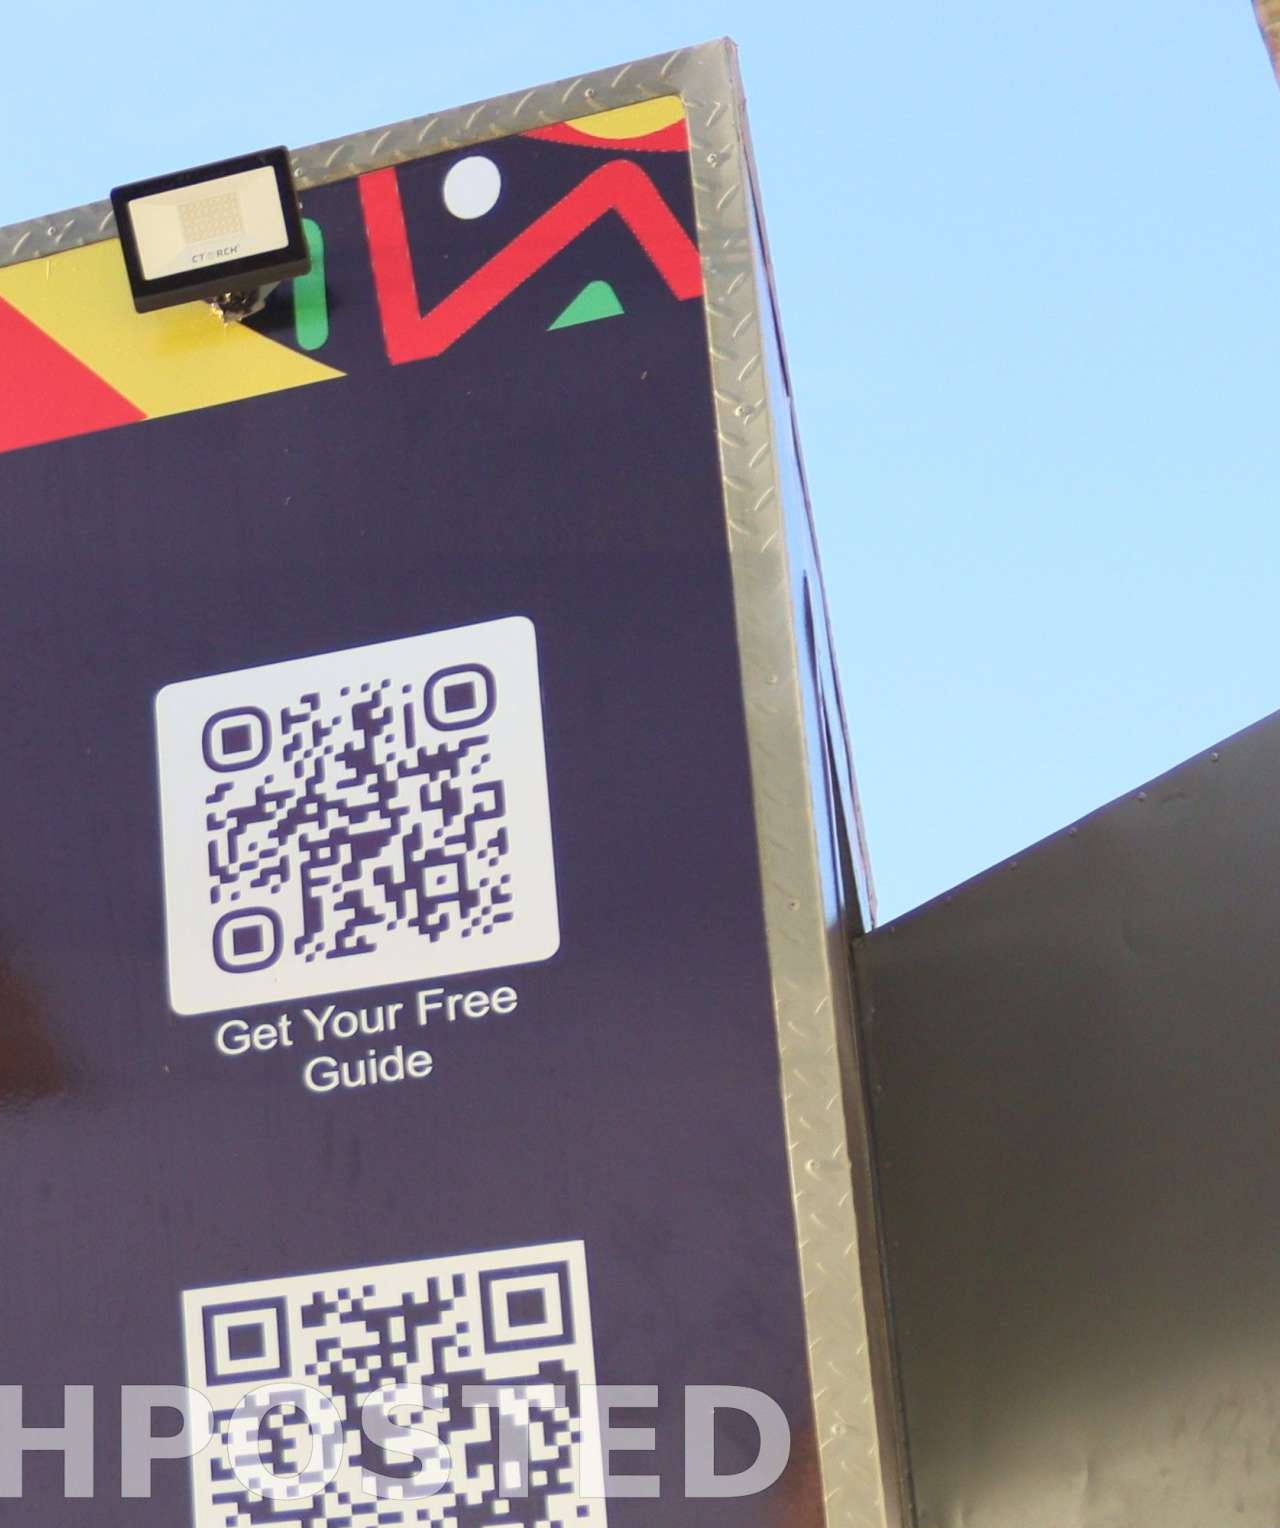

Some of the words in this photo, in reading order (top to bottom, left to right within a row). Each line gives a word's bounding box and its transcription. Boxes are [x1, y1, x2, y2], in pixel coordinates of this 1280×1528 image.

[215, 1014, 293, 1055] Get
[302, 1000, 403, 1042] Your
[416, 985, 519, 1026] Free
[302, 1045, 434, 1092] Guide
